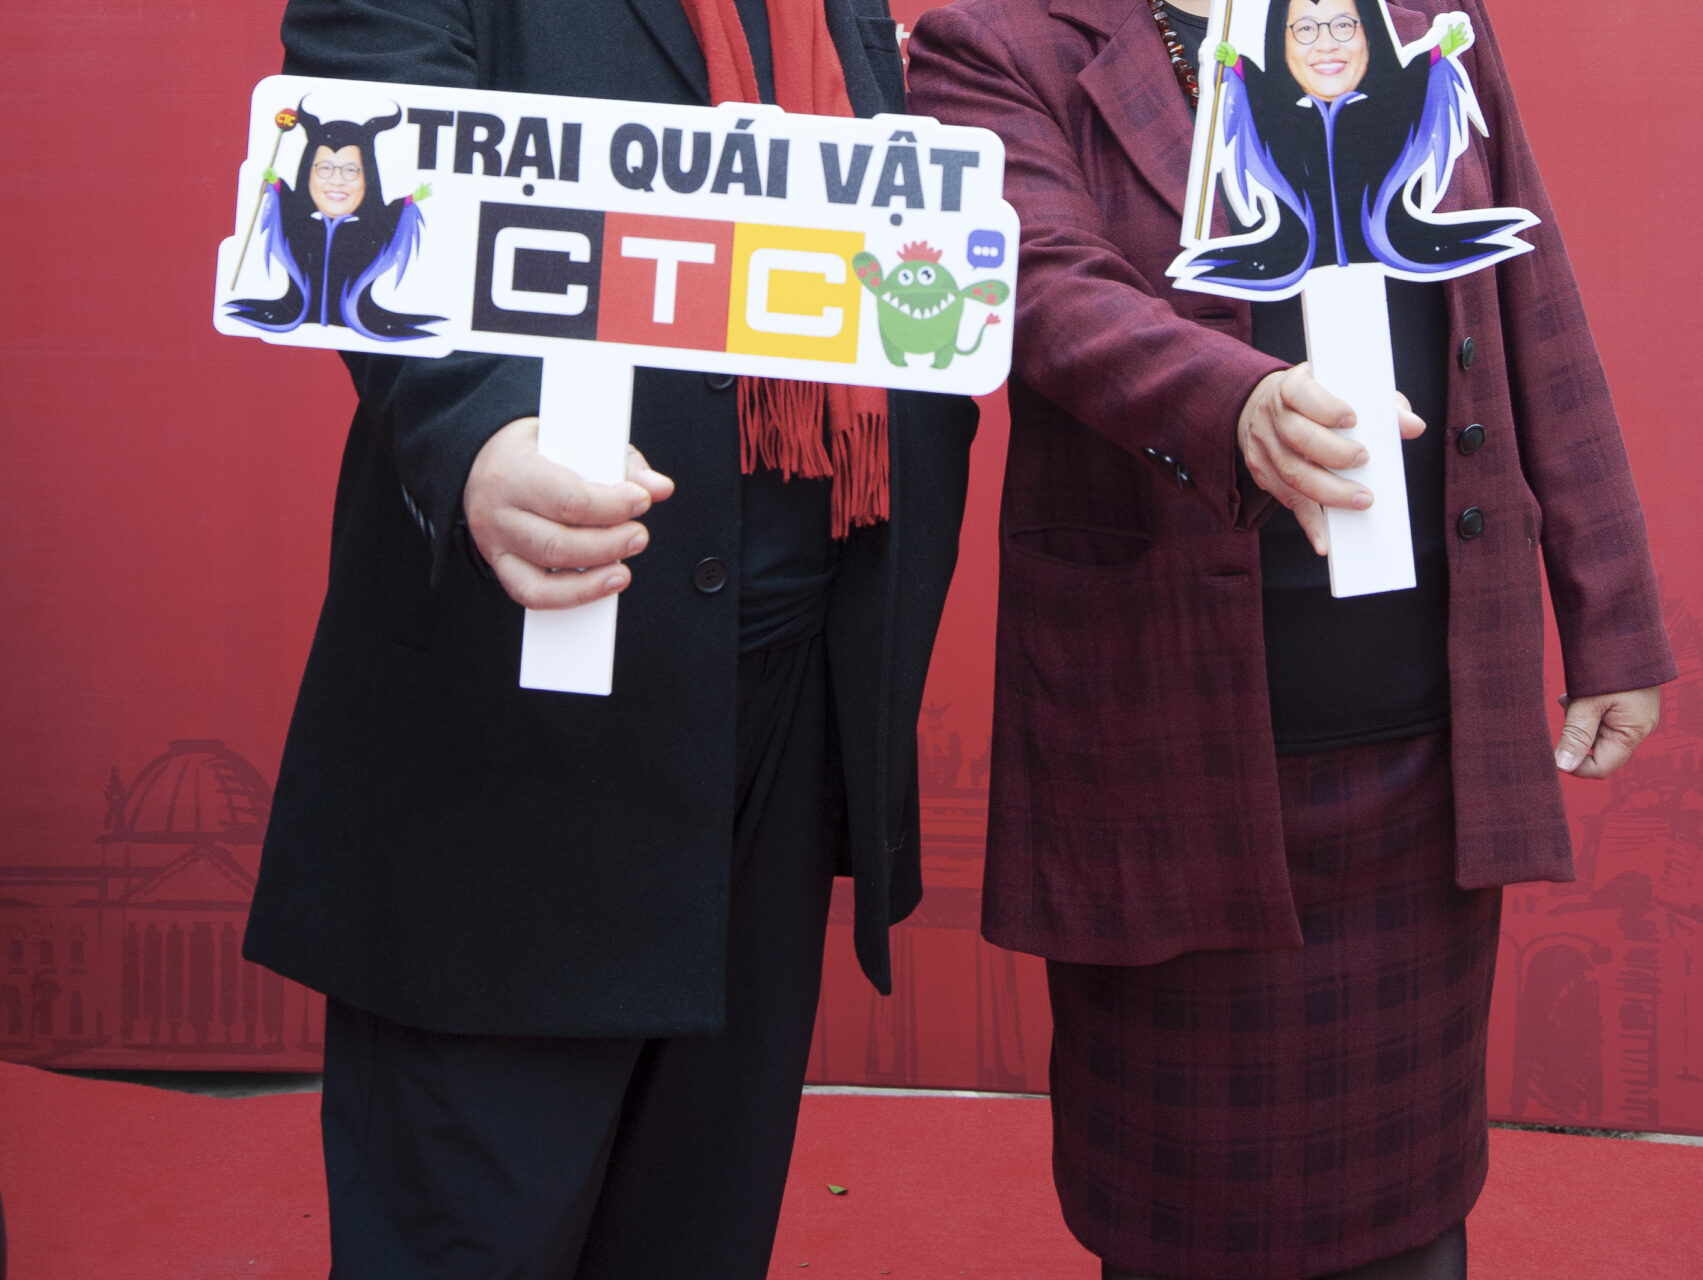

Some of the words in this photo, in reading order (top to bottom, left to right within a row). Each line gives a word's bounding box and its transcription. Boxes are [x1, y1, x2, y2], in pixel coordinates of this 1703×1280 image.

[407, 108, 582, 197] TRẠI
[610, 119, 790, 199] QUÁI
[819, 130, 980, 226] VẬT
[491, 227, 848, 338] CTC
